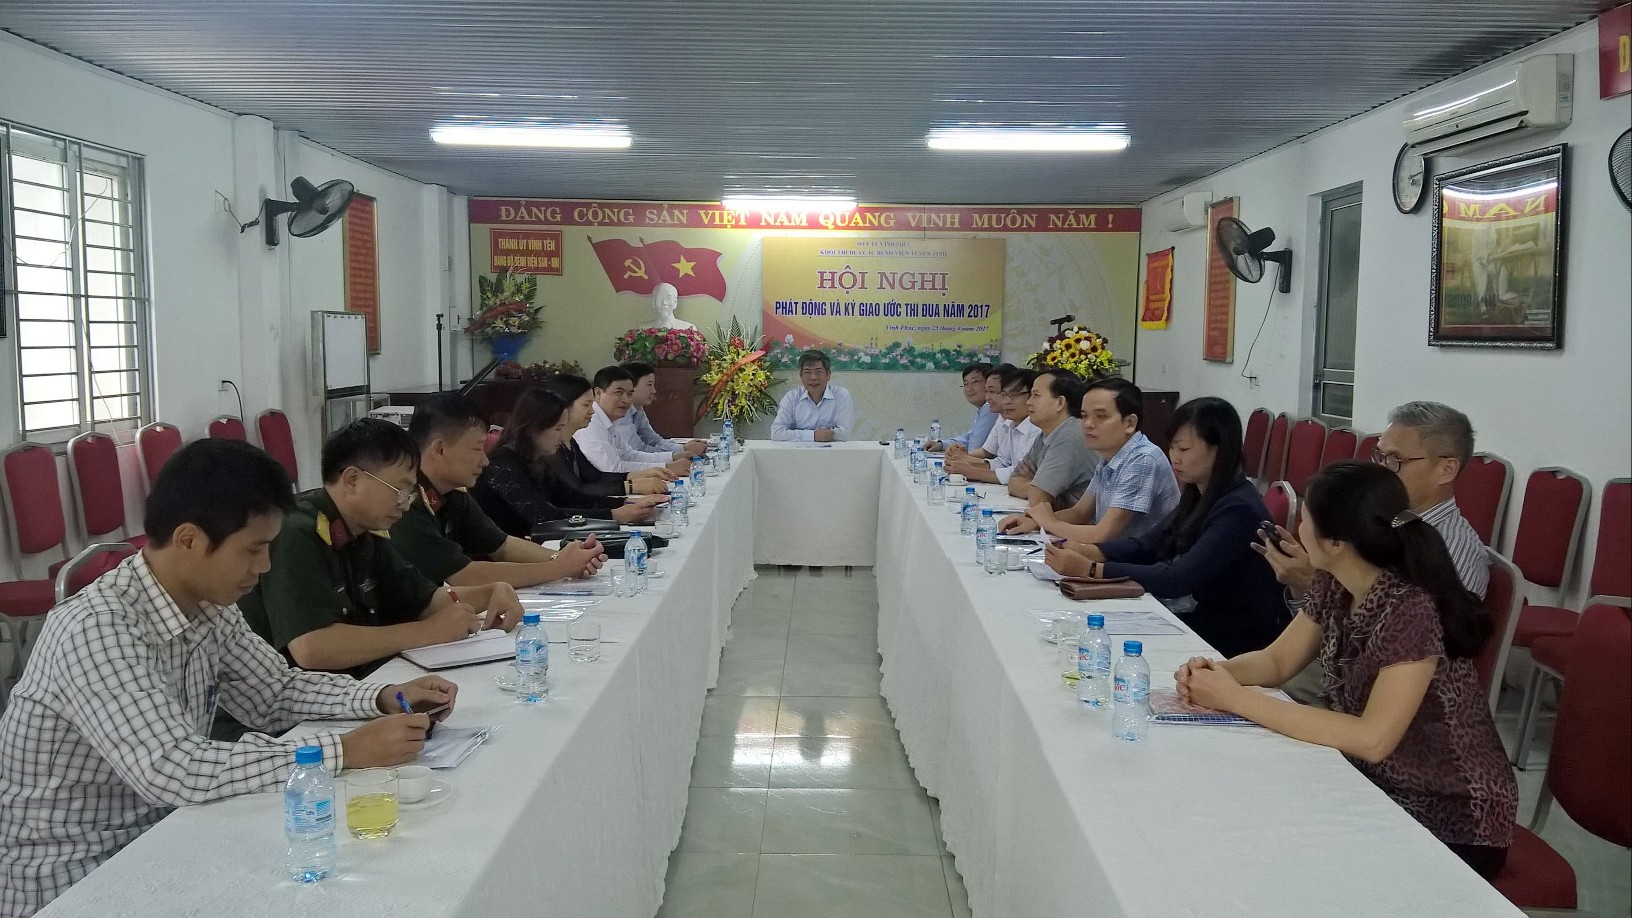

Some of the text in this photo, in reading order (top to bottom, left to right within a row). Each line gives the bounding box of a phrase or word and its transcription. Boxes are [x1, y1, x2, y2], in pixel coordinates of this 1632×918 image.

[499, 201, 1114, 229] ĐẢNG CỘNG SẢN VIỆT NAM QUANG VINH MUÔN NĂM !
[817, 264, 949, 297] HỘI NGHỊ
[775, 298, 991, 319] PHÁT ĐỘNG VÀ KÝ GIAO ƯỚC THI ĐUA NĂM 2017
